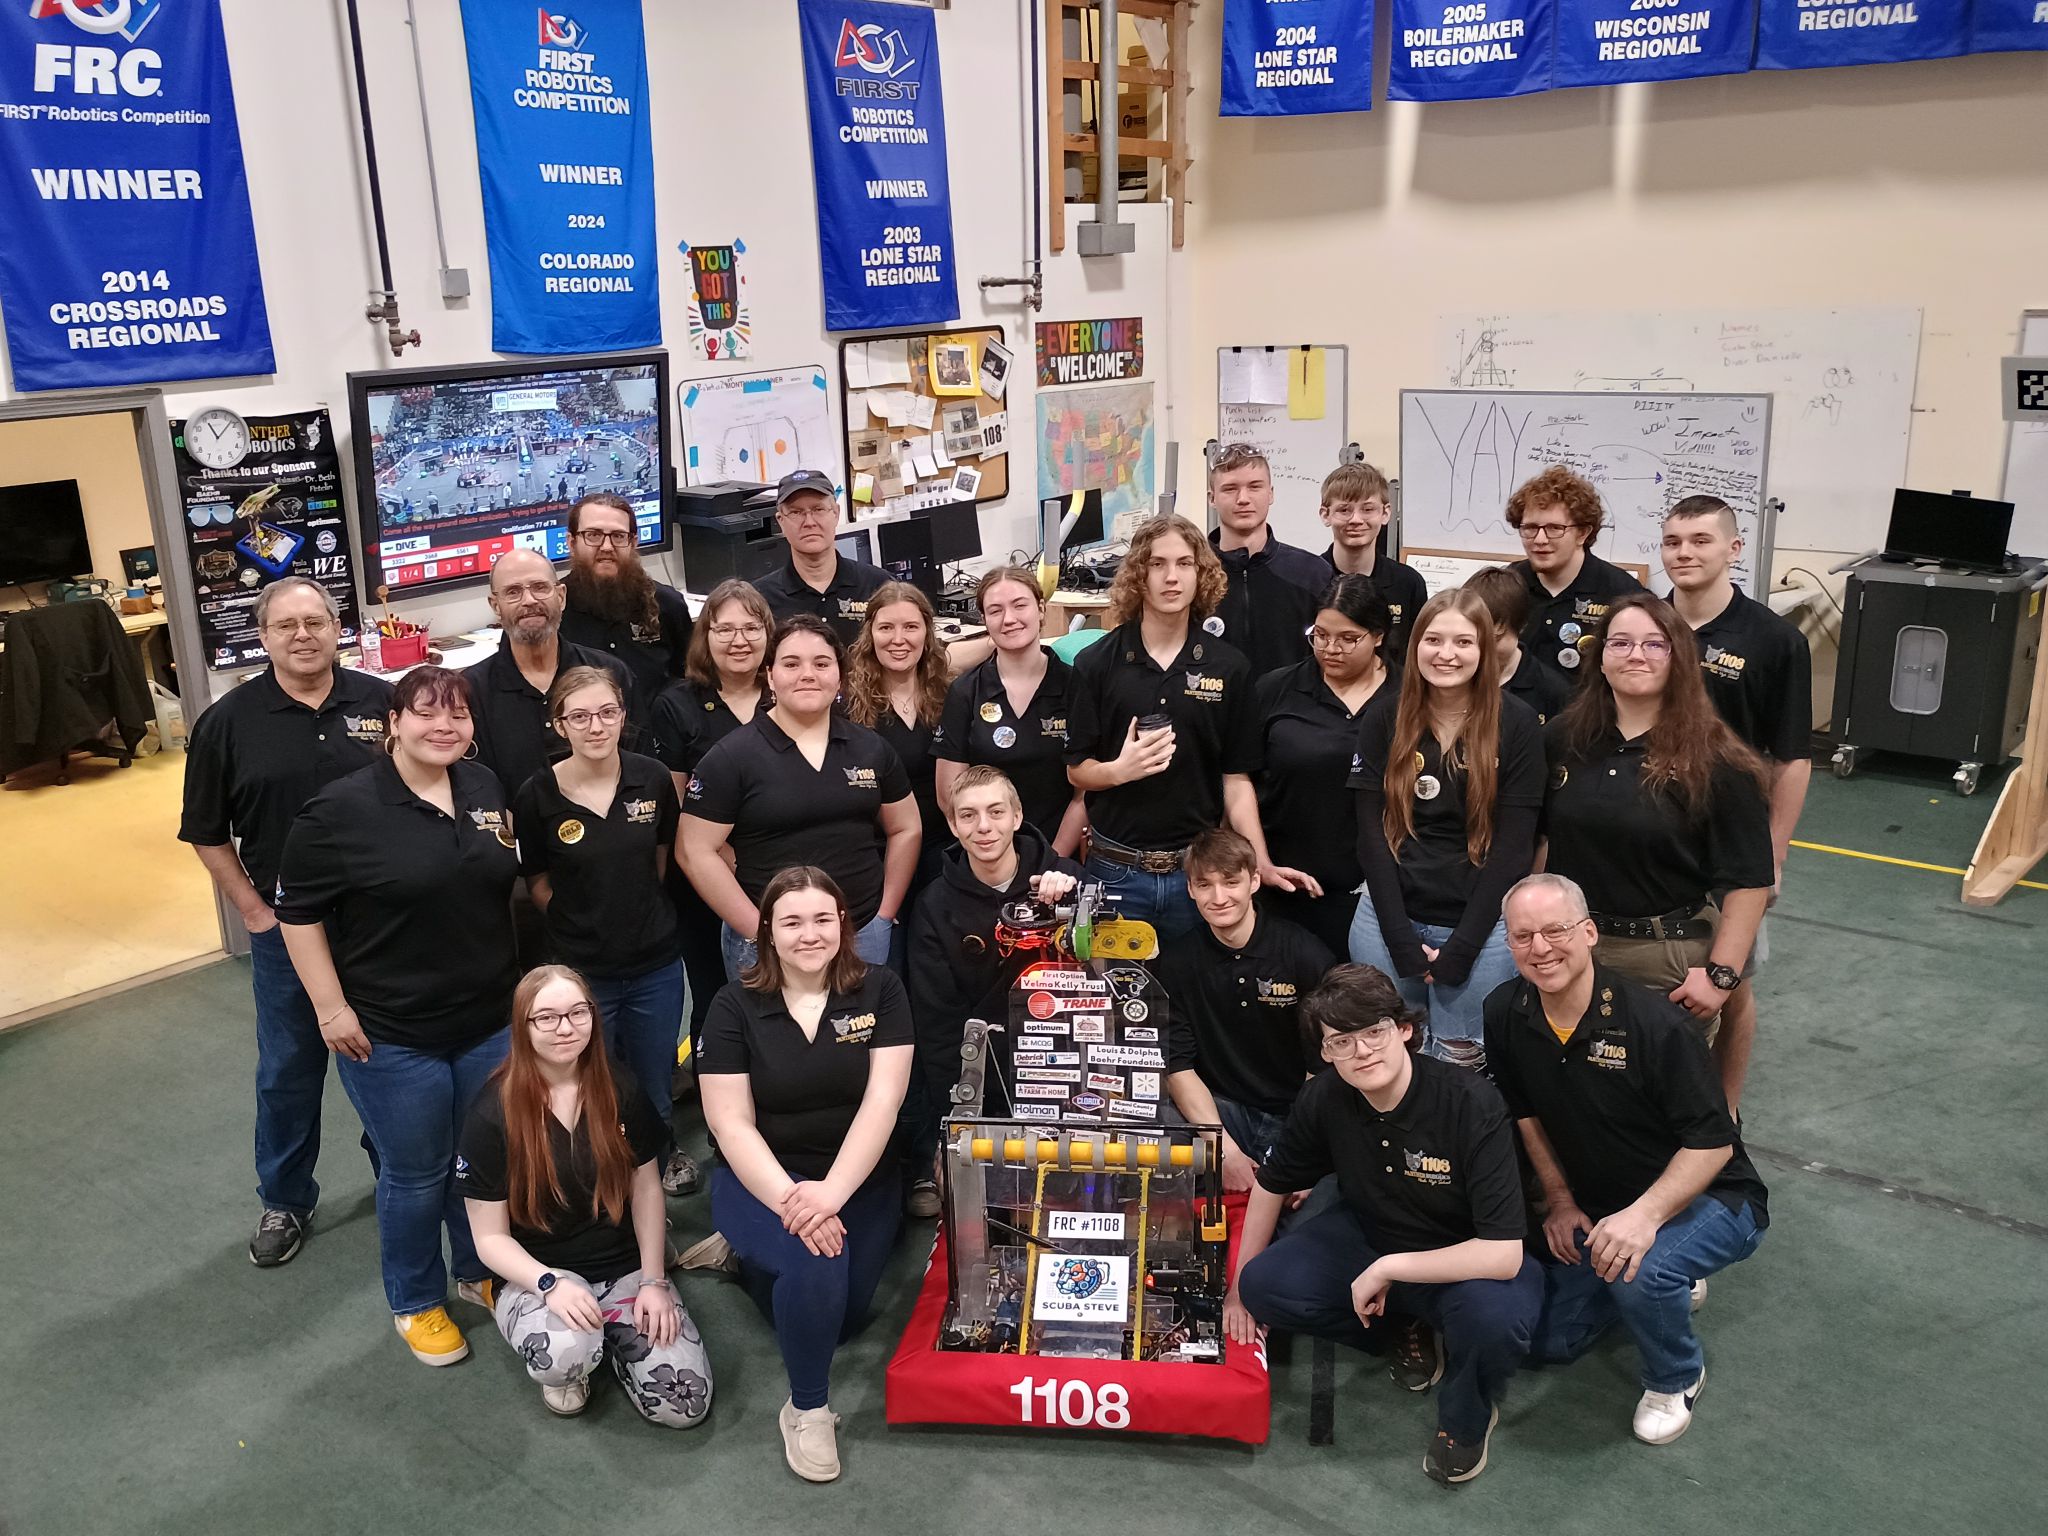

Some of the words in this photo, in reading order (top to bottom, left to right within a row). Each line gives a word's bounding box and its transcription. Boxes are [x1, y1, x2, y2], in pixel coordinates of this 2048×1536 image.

[1443, 4, 1486, 25] 2005
[1594, 10, 1710, 39] WISCONSIN
[1799, 2, 1918, 31] REGIONAL
[1275, 26, 1317, 46] 2004
[1403, 19, 1524, 47] BOILERMAKER
[1255, 51, 1293, 69] LONE
[1297, 46, 1337, 66] STAR
[1410, 42, 1518, 68] REGIONAL
[1599, 35, 1702, 61] REGIONAL
[34, 43, 163, 97] FRC
[539, 49, 595, 73] FIRST
[525, 69, 612, 93] ROBOTICS
[1256, 67, 1334, 88] REGIONAL
[835, 77, 920, 100] FIRST
[514, 90, 630, 115] COMPETITION
[48, 106, 118, 121] Robotics
[121, 109, 211, 125] Competition
[852, 107, 914, 126] ROBOTICS
[839, 125, 928, 145] COMPETITION
[31, 168, 203, 200] WINNER
[539, 163, 623, 186] WINNER
[866, 180, 928, 200] WINNER
[567, 214, 606, 229] 2024
[884, 226, 922, 245] 2003
[539, 253, 635, 271] COLORADO
[696, 250, 730, 271] YOU
[861, 247, 904, 267] LONE
[907, 245, 941, 264] STAR
[101, 270, 170, 294] 2014
[545, 275, 634, 294] REGIONAL
[702, 273, 730, 299] GOT
[866, 265, 940, 288] REGIONAL
[49, 296, 227, 325] CROSSROADS
[706, 302, 731, 320] THIS
[68, 321, 220, 350] REGIONAL
[1046, 320, 1133, 354] EVERYONE
[1057, 351, 1125, 382] WELCOME
[509, 392, 534, 400] GENERAL
[1415, 396, 1532, 520] YAY
[200, 468, 239, 480] Thanks
[240, 466, 251, 476] to
[252, 464, 269, 476] our
[271, 460, 317, 477] Sponsors
[502, 523, 534, 534] Qualification
[396, 540, 417, 551] DIVE
[1719, 652, 1746, 670] 1108
[1200, 677, 1224, 692] 1108
[1054, 981, 1079, 991] Kelly
[1080, 982, 1104, 990] Trust
[1060, 972, 1085, 981] Option
[1272, 982, 1297, 996] 1108
[1063, 998, 1106, 1009] TRANE
[849, 1012, 876, 1031] 1108
[1096, 1046, 1118, 1054] Louis
[1128, 1048, 1159, 1058] Dolpha
[1117, 1056, 1166, 1067] Foundation
[1015, 1104, 1056, 1115] Holman
[1421, 1156, 1451, 1173] 1108
[1054, 1215, 1076, 1231] FRC
[1081, 1217, 1120, 1232] #1108
[1042, 1301, 1081, 1311] SCUBA
[1084, 1302, 1119, 1312] STEVE
[1010, 1375, 1131, 1429] 1108
